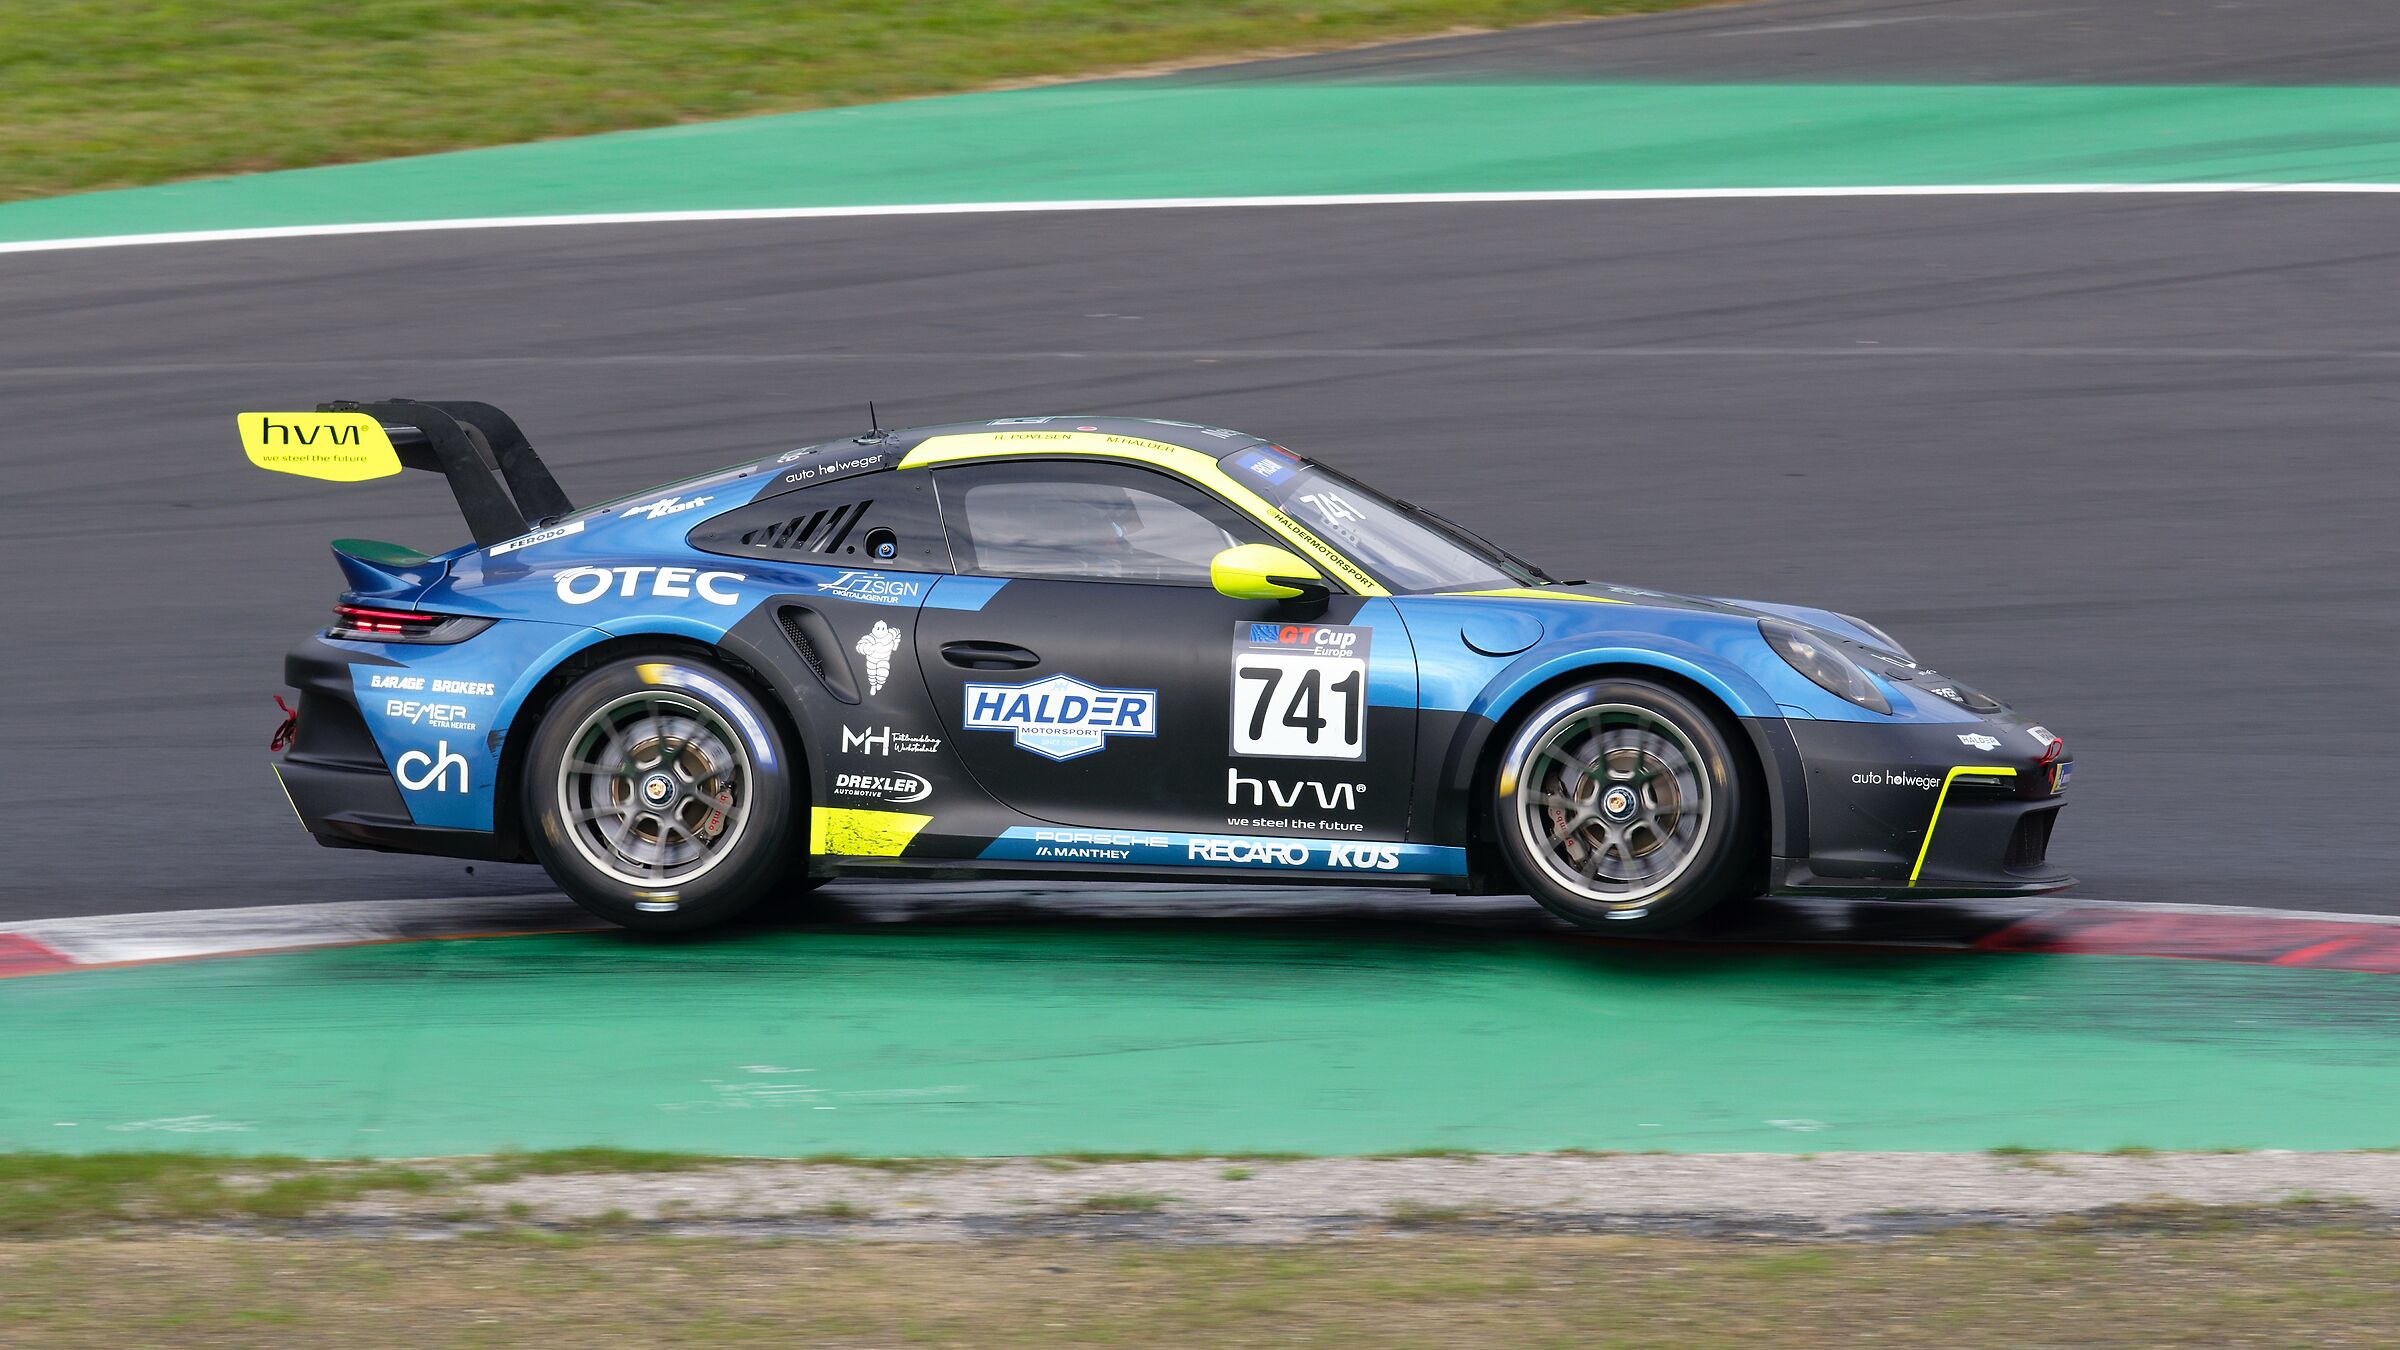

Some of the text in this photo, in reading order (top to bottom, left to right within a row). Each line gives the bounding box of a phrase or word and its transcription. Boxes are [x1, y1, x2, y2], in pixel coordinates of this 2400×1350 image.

[282, 454, 309, 462] steel
[312, 454, 330, 462] the
[333, 454, 367, 463] future
[785, 470, 815, 483] auto
[819, 454, 882, 476] holweger
[1300, 492, 1366, 526] 741
[509, 528, 566, 550] FERODO
[553, 565, 747, 606] OTEC
[832, 590, 899, 603] DIGITALAGENTUR
[1279, 625, 1357, 649] GT Cup
[1313, 646, 1353, 658] Europe
[371, 675, 495, 696] GARAGE BROKERS
[386, 699, 467, 725] BEMER
[972, 692, 1147, 727] HALDER
[1239, 667, 1360, 746] 741
[429, 719, 476, 730] PETRA HERTER
[1021, 727, 1099, 737] MOTORSPORT
[1962, 735, 1998, 746] HALDER
[396, 740, 469, 793] ch
[836, 773, 918, 793] DREXLER
[1851, 769, 1941, 790] auto holweger
[834, 788, 882, 798] AUTOMOTIVE
[1227, 817, 1364, 832] we steel the future
[1035, 831, 1169, 848] PORSCHE
[1054, 847, 1130, 859] MANTHEY
[1188, 838, 1310, 866] RECARO
[1327, 843, 1401, 870] KUS
